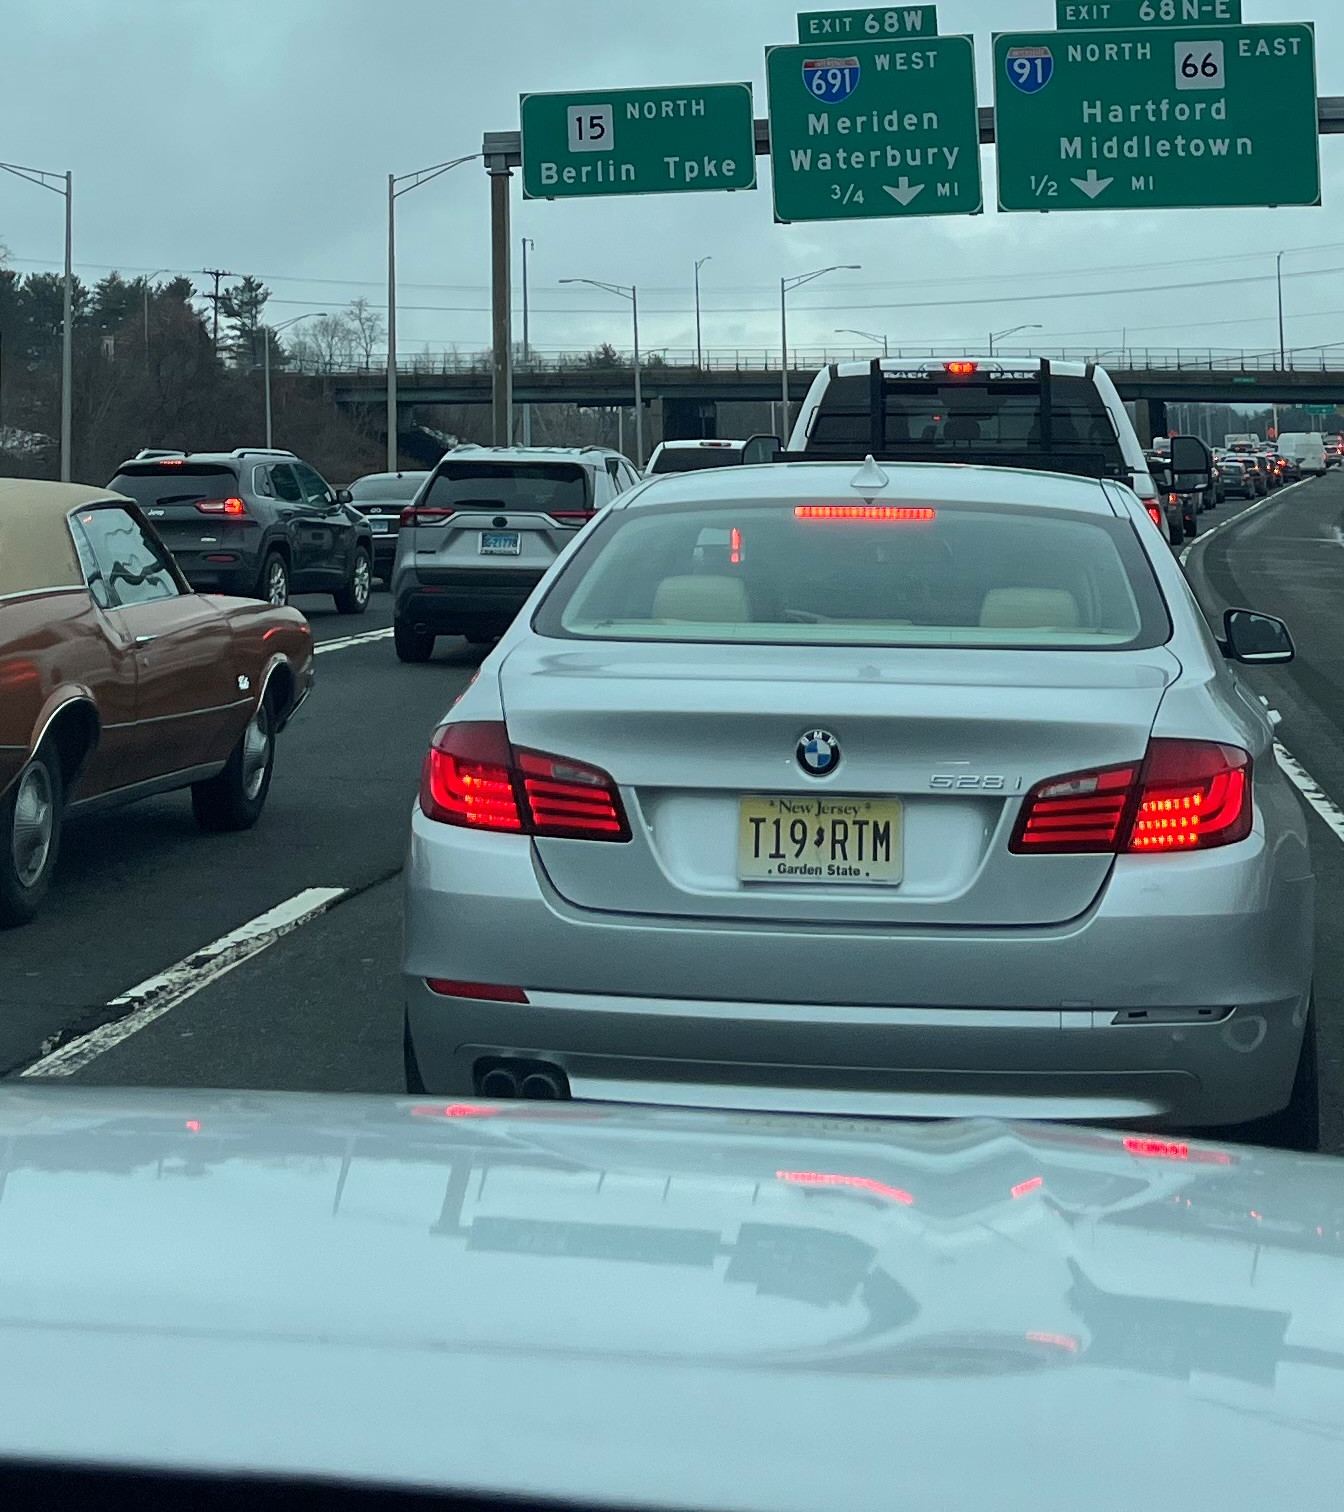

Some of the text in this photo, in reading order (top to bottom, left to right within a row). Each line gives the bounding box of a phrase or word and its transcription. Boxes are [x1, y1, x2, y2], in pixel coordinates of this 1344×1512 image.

[810, 10, 923, 35] EXIT 68W
[1066, 4, 1111, 21] EXIT
[1068, 42, 1152, 62] NORTH
[1238, 38, 1301, 57] EAST
[875, 51, 938, 71] WEST
[1013, 58, 1043, 84] 91
[1181, 52, 1219, 79] 66
[812, 68, 851, 95] 691
[626, 99, 706, 120] NORTH
[1083, 98, 1227, 123] Hartford
[575, 115, 605, 140] 15
[808, 109, 939, 136] Meriden
[789, 145, 960, 172] Waterbury
[1060, 136, 1253, 160] Middletown
[541, 156, 736, 185] Berlin Tpke
[831, 182, 959, 205] 3/4 MI
[1030, 175, 1154, 196] 1/2 MI
[778, 800, 860, 816] New Jersey
[777, 863, 861, 877] Garden State
